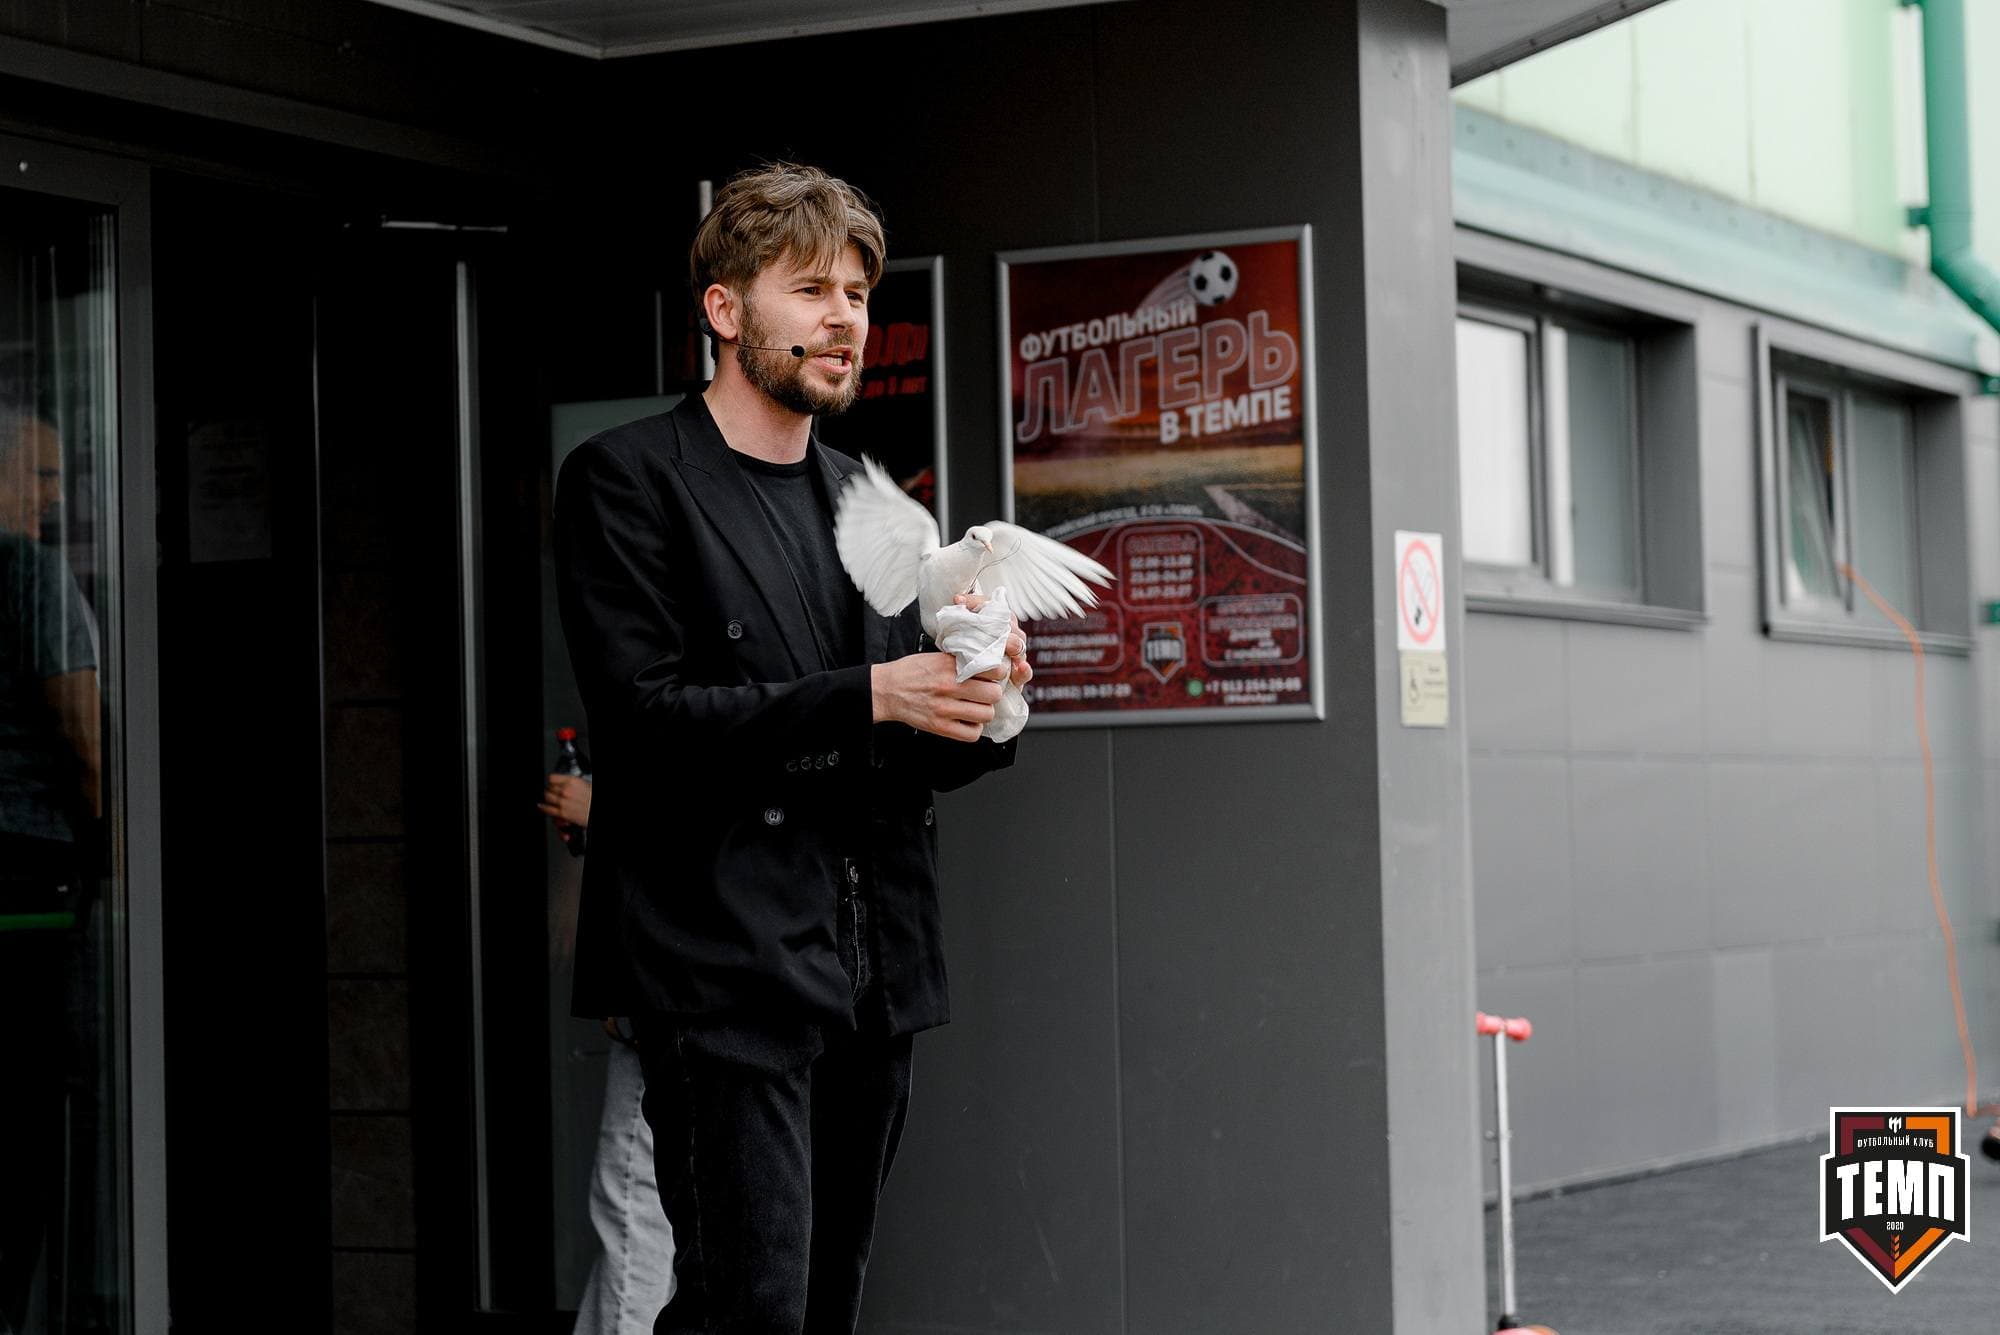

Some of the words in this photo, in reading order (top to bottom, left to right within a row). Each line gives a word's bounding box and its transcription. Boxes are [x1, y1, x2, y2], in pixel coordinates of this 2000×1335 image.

[1019, 301, 1197, 361] ФУТБОЛЬНЫЙ
[1016, 309, 1298, 444] ЛАГЕРЬ
[1160, 411, 1180, 444] В
[1186, 385, 1292, 436] ТЕМПЕ
